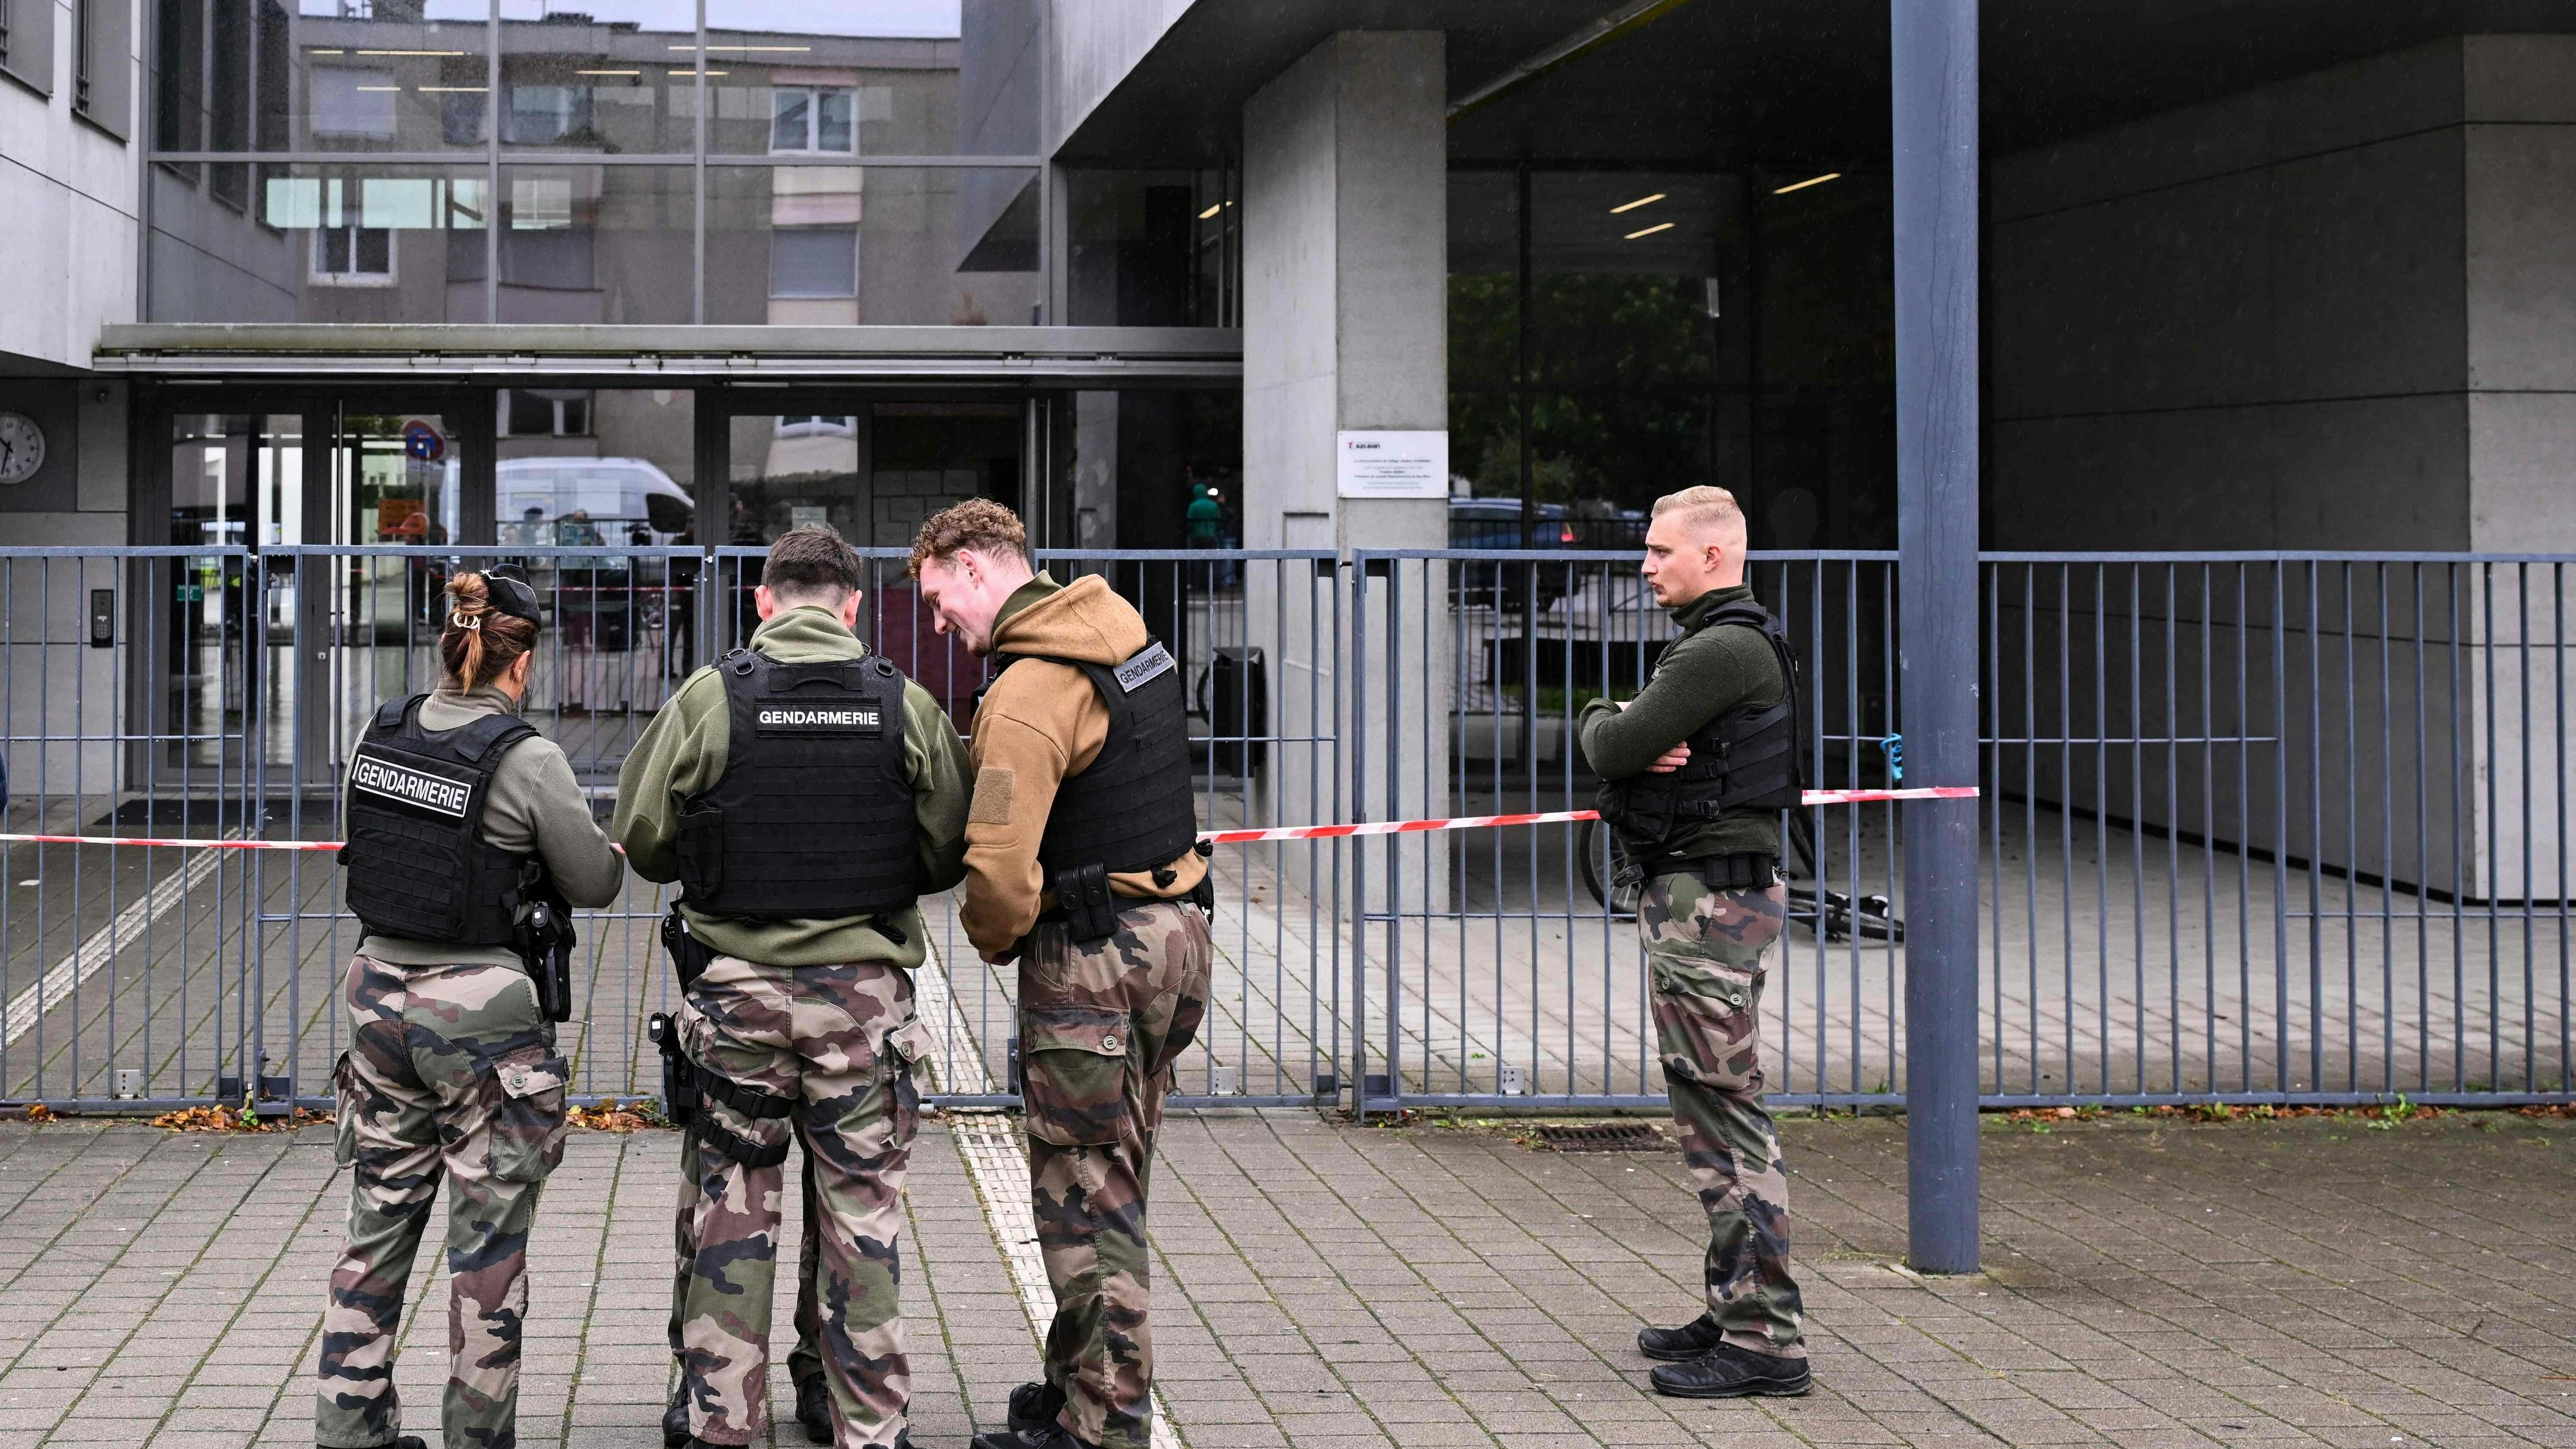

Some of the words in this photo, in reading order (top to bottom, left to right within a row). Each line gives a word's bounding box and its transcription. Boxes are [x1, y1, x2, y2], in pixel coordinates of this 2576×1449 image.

[1120, 650, 1169, 684] GENDARMERIE
[759, 710, 879, 725] GENDARMERIE
[358, 762, 466, 810] GENDARMERIE
